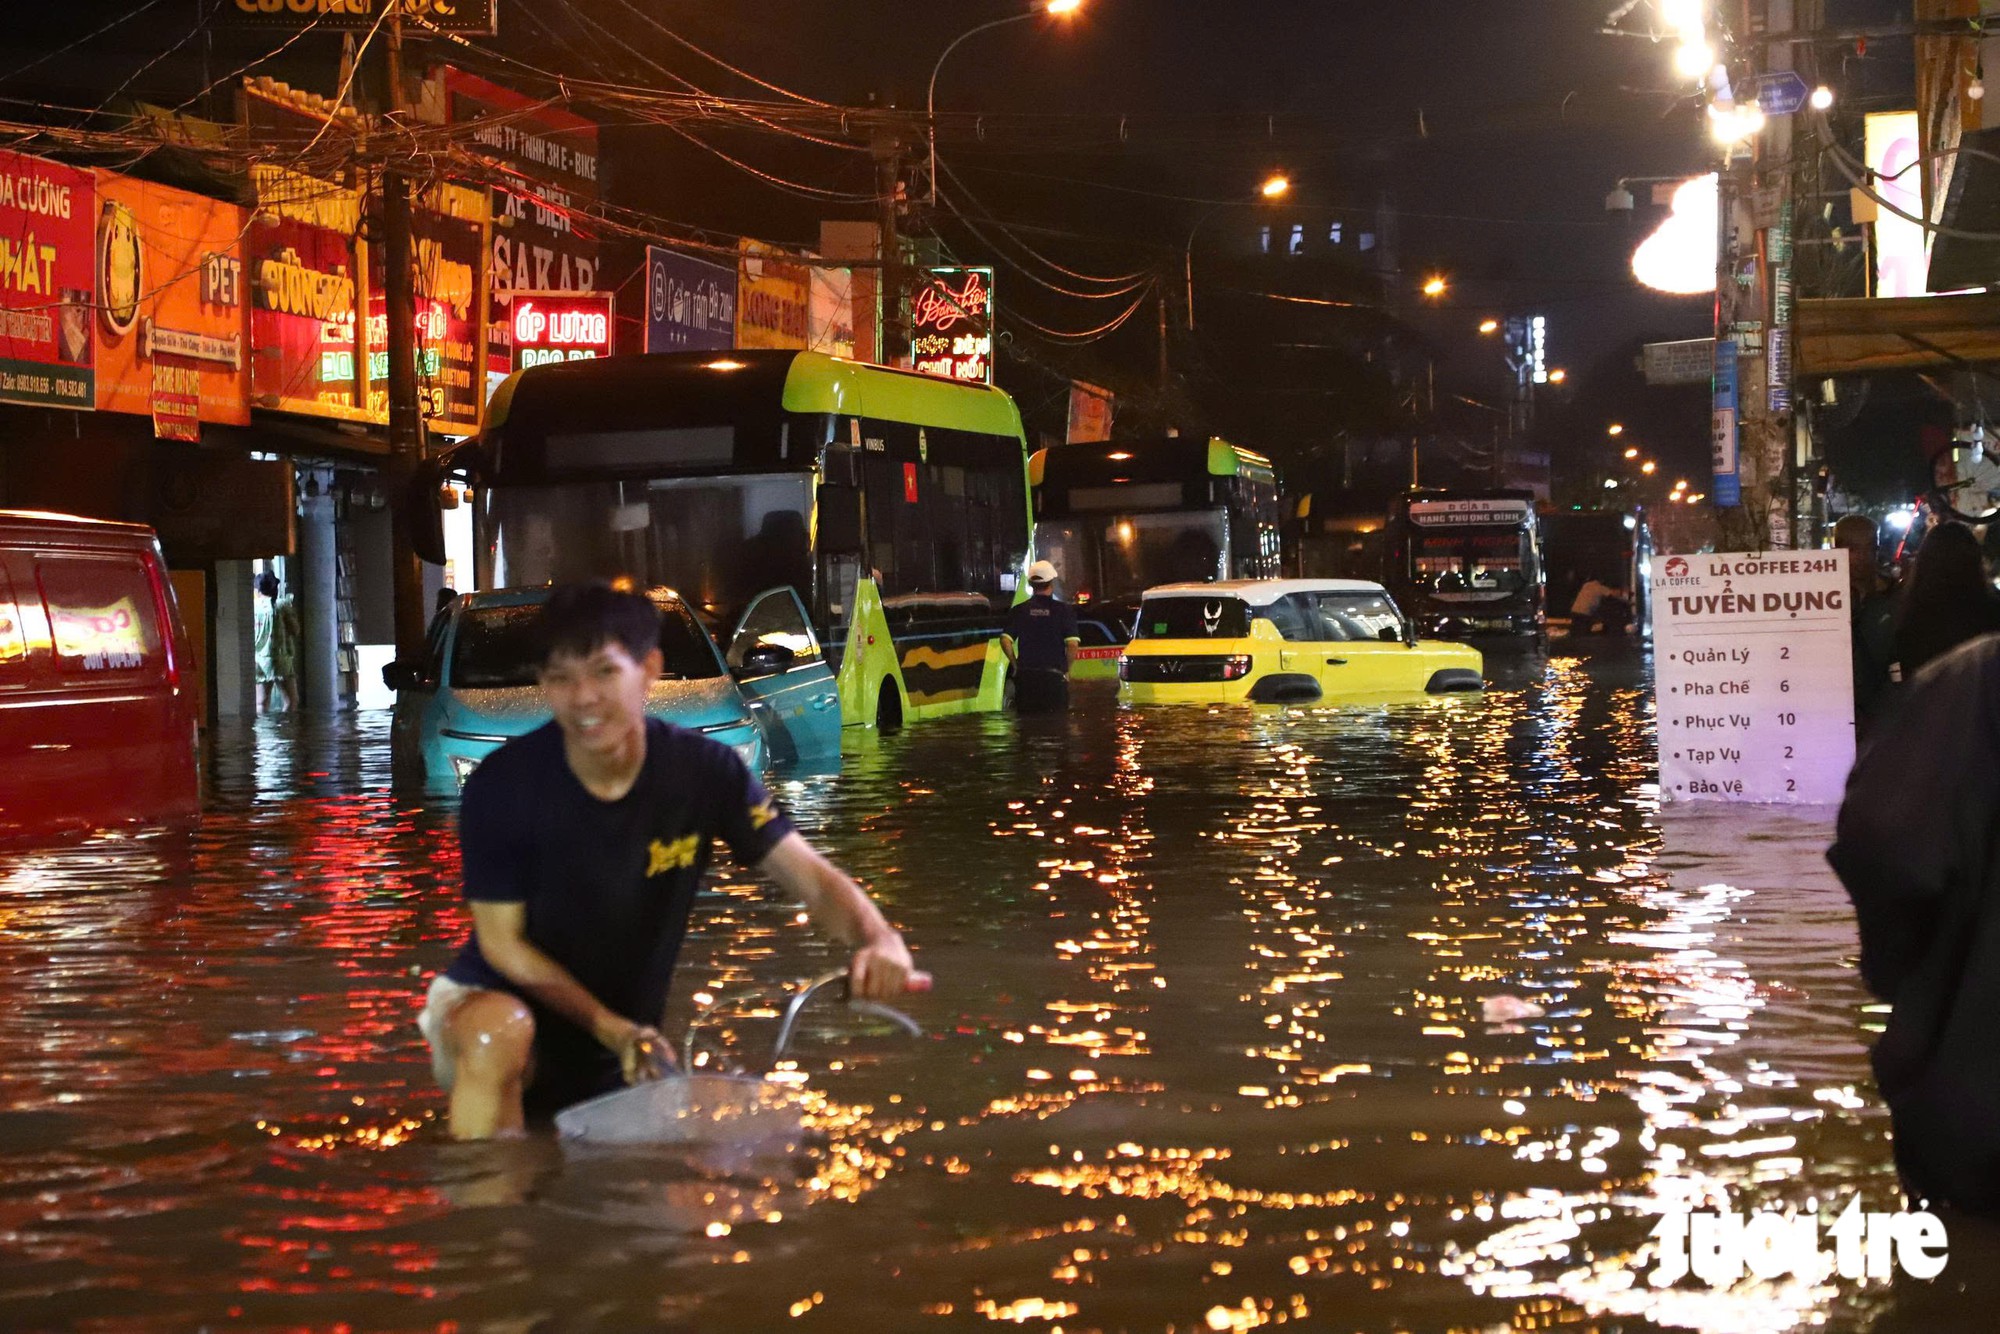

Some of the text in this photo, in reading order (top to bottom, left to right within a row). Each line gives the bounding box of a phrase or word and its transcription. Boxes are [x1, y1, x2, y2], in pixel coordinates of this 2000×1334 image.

[520, 132, 545, 163] TNHH
[575, 151, 597, 180] BIKE
[207, 254, 241, 306] PET
[515, 302, 546, 342] ỐP
[549, 310, 607, 344] LƯNG
[864, 437, 885, 452] VINBUS
[1710, 559, 1837, 577] LA COFFEE 24H
[1656, 577, 1701, 587] LA COFFEE
[1668, 580, 1842, 618] TUYỂN DỤNG
[1683, 647, 1790, 665] Quản Lý 2
[1684, 680, 1790, 695] Pha Chế 6
[1686, 713, 1796, 731] Phục Vụ 10
[1686, 746, 1794, 764] Tạp Vụ 2
[1689, 779, 1796, 796] Bảo Vệ 2
